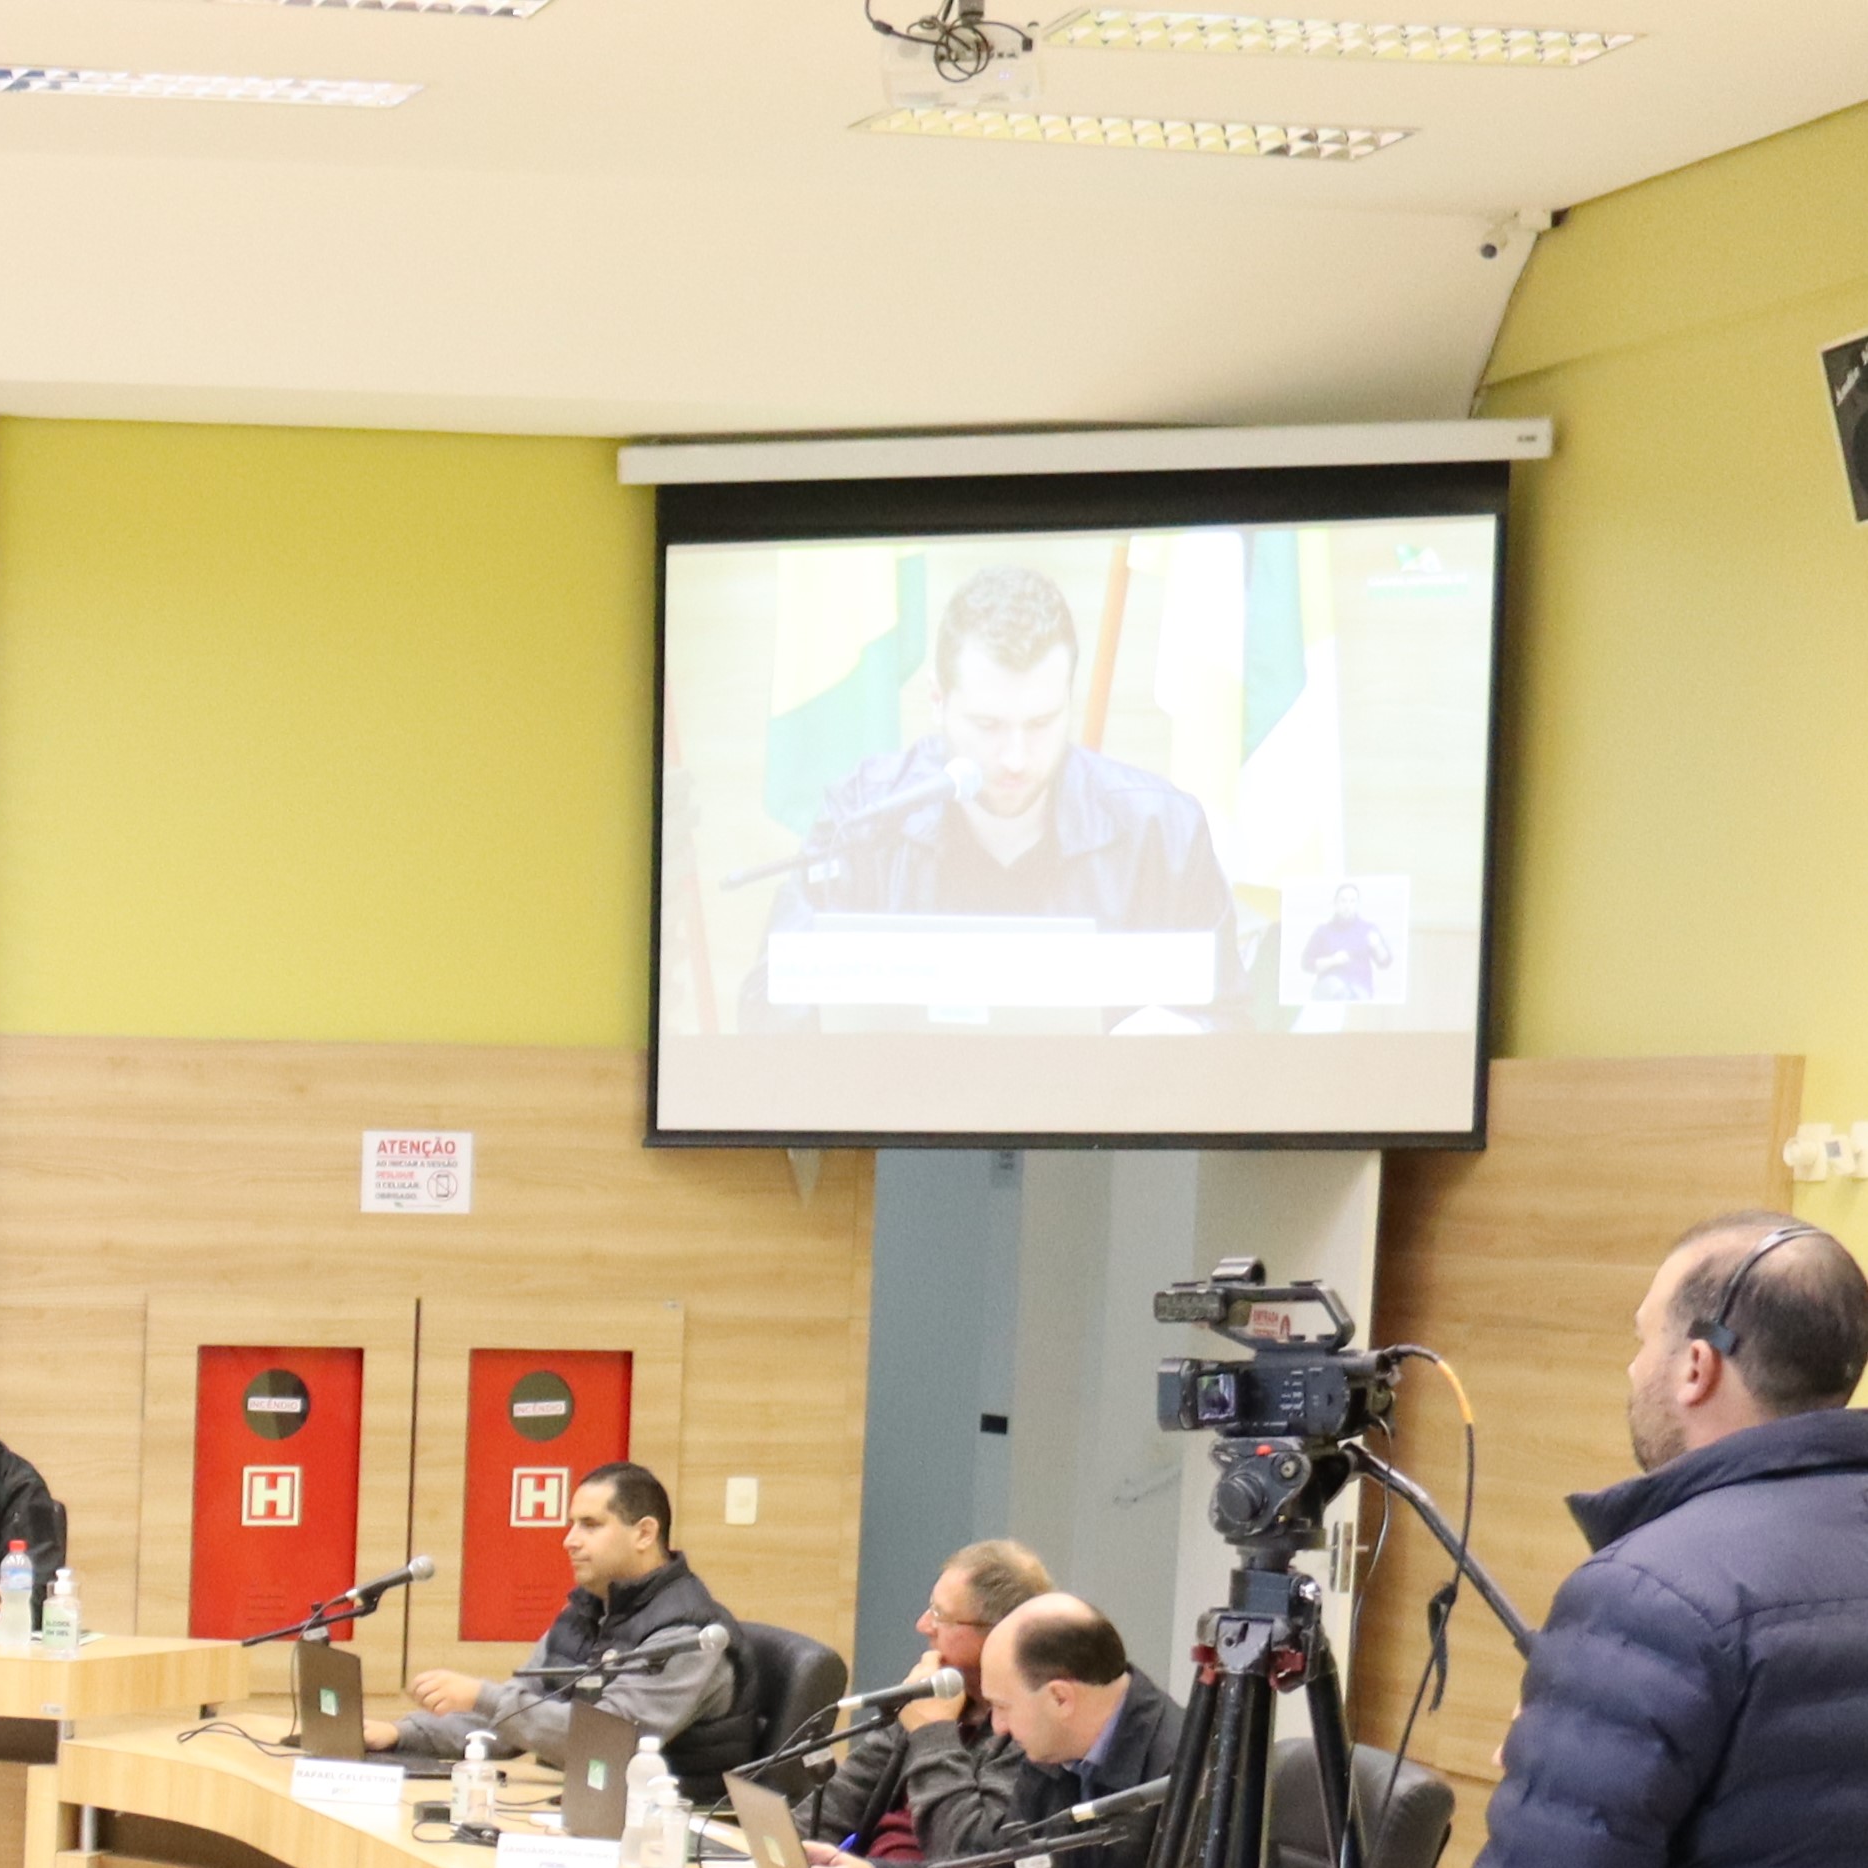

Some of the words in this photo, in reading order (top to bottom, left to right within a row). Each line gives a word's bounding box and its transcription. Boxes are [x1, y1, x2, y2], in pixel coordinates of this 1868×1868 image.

[376, 1137, 456, 1158] ATENÇÃO
[249, 1398, 299, 1411] INCÊNDIO
[515, 1403, 564, 1415] INCÊNDIO
[251, 1475, 292, 1516] H
[519, 1477, 560, 1517] H
[296, 1769, 336, 1780] RAFAEL
